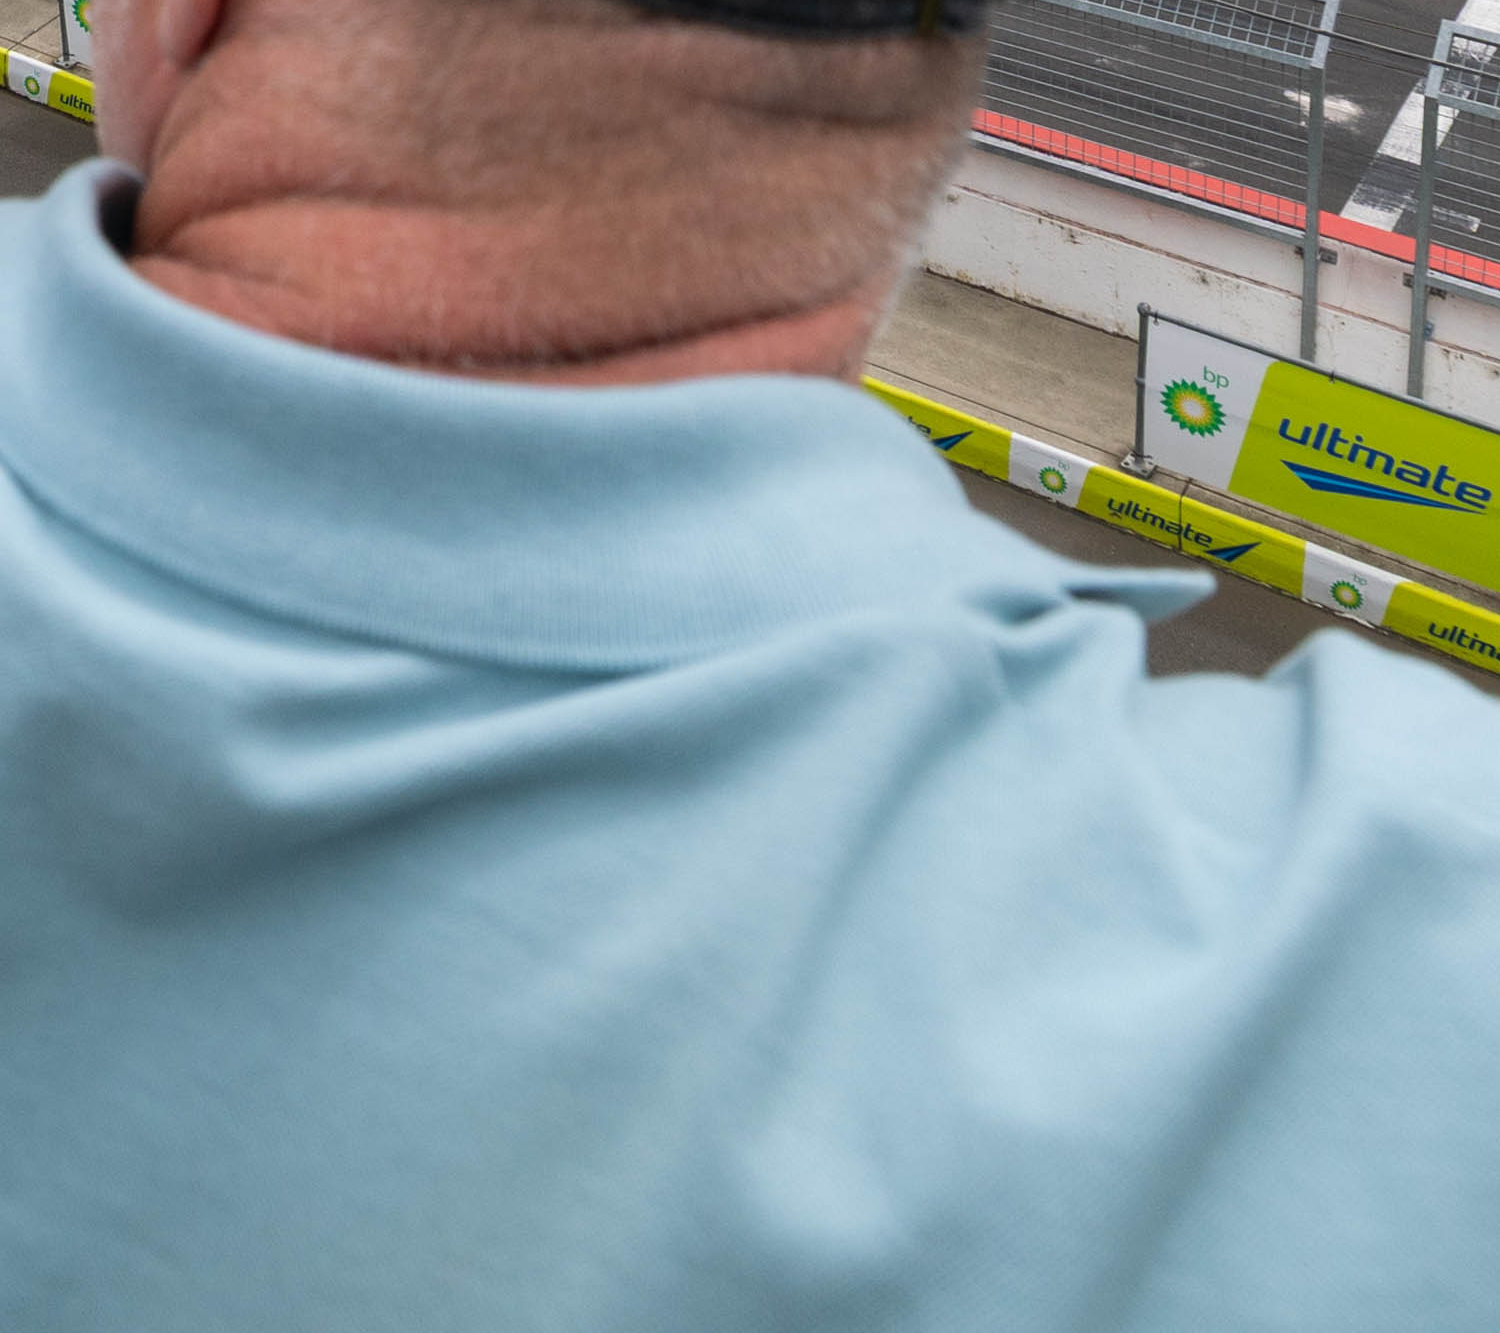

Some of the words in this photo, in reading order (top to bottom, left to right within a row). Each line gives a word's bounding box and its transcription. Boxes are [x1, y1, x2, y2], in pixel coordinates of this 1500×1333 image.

[59, 91, 95, 114] ultim
[1202, 365, 1230, 391] bp
[1277, 416, 1492, 512] ultimate
[1107, 495, 1213, 549] ultimate
